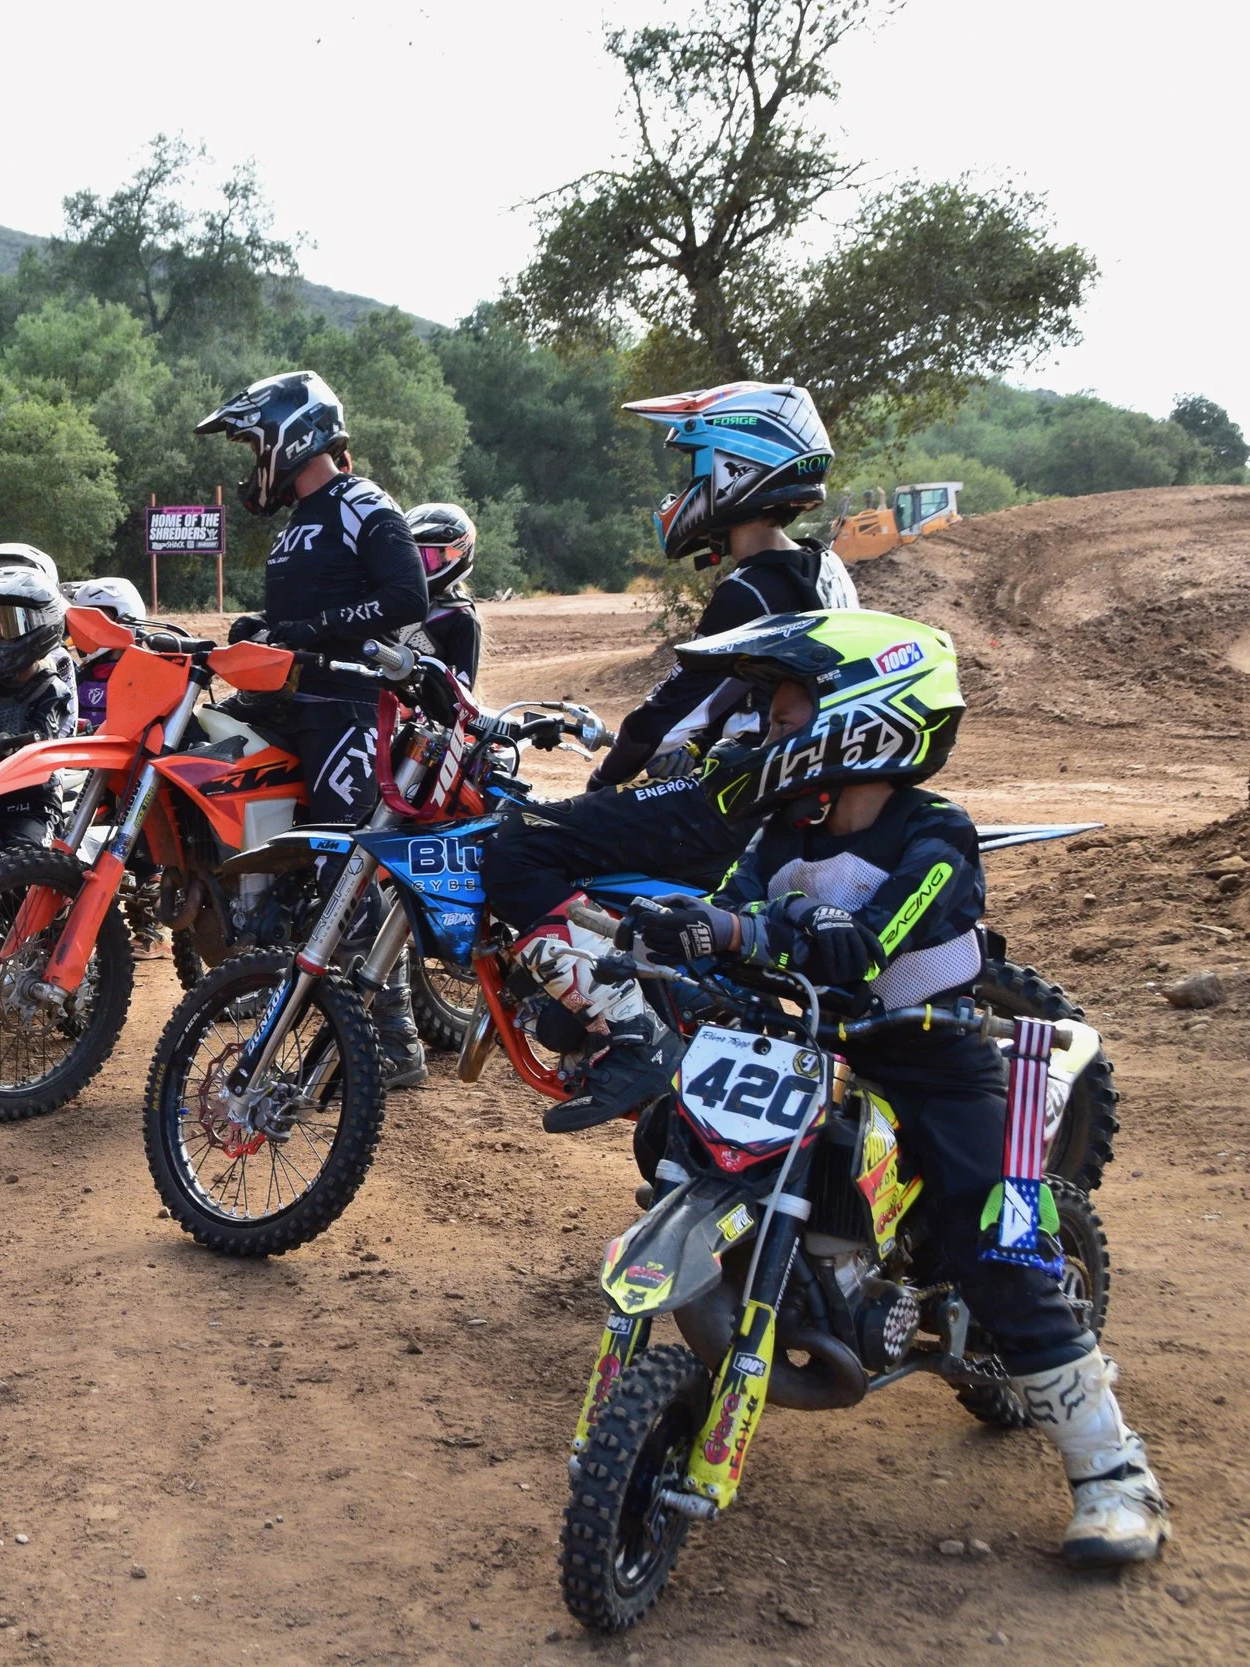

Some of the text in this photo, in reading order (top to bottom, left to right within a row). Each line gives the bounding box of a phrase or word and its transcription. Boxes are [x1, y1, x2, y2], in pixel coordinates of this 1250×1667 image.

[712, 415, 758, 426] FORGE
[285, 430, 314, 460] FLY
[151, 513, 220, 527] HOME OF THE
[149, 527, 207, 541] SHREDDERS
[881, 644, 920, 673] 100%
[317, 840, 340, 851] KTM
[412, 878, 476, 893] CYBE
[319, 880, 356, 944] SUSPENSION
[882, 868, 944, 945] RACING
[184, 1011, 201, 1034] EXCEL
[247, 979, 287, 1056] DUNLOP
[152, 1063, 166, 1111] MAXXIS
[685, 1057, 820, 1132] 420
[736, 1356, 766, 1376] 100%
